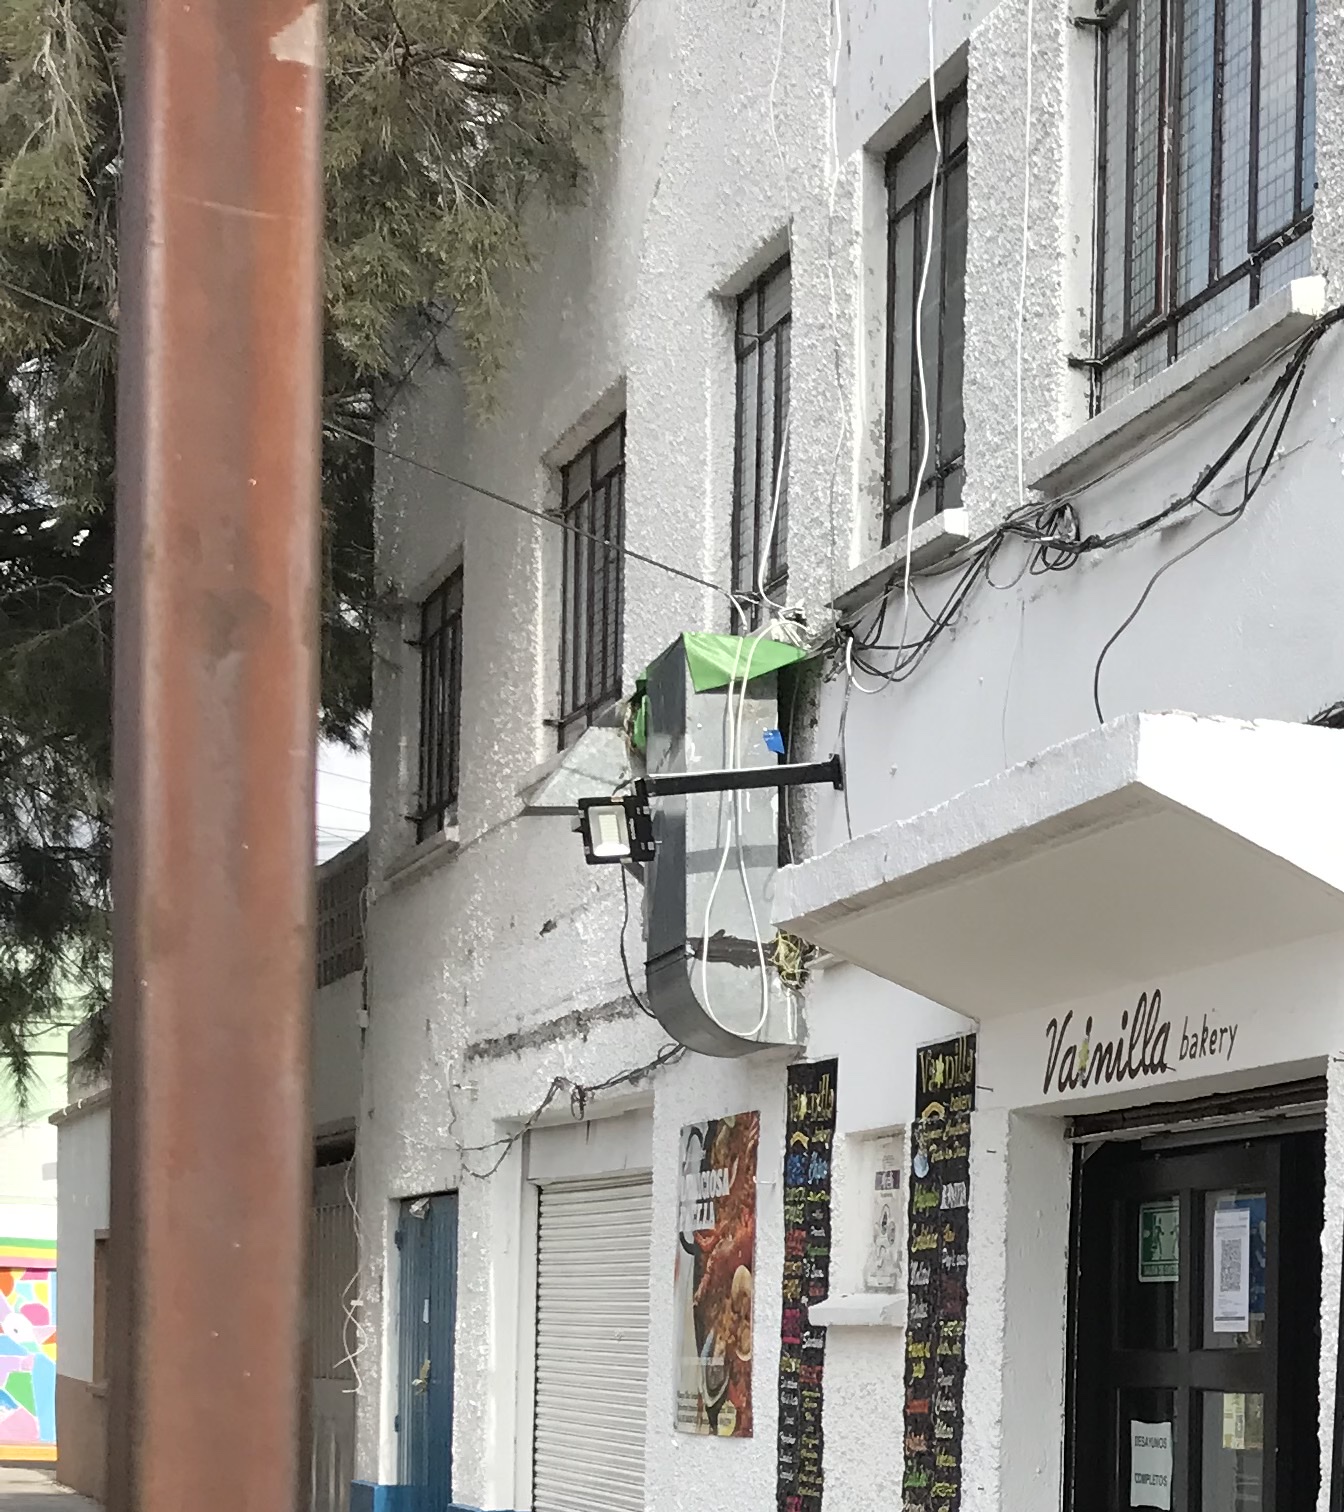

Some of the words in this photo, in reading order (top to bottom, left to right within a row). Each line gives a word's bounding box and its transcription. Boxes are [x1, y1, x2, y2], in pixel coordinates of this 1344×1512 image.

[918, 1035, 974, 1093] Vanilla
[1043, 988, 1174, 1095] Vainilla
[1179, 1013, 1238, 1061] bakery
